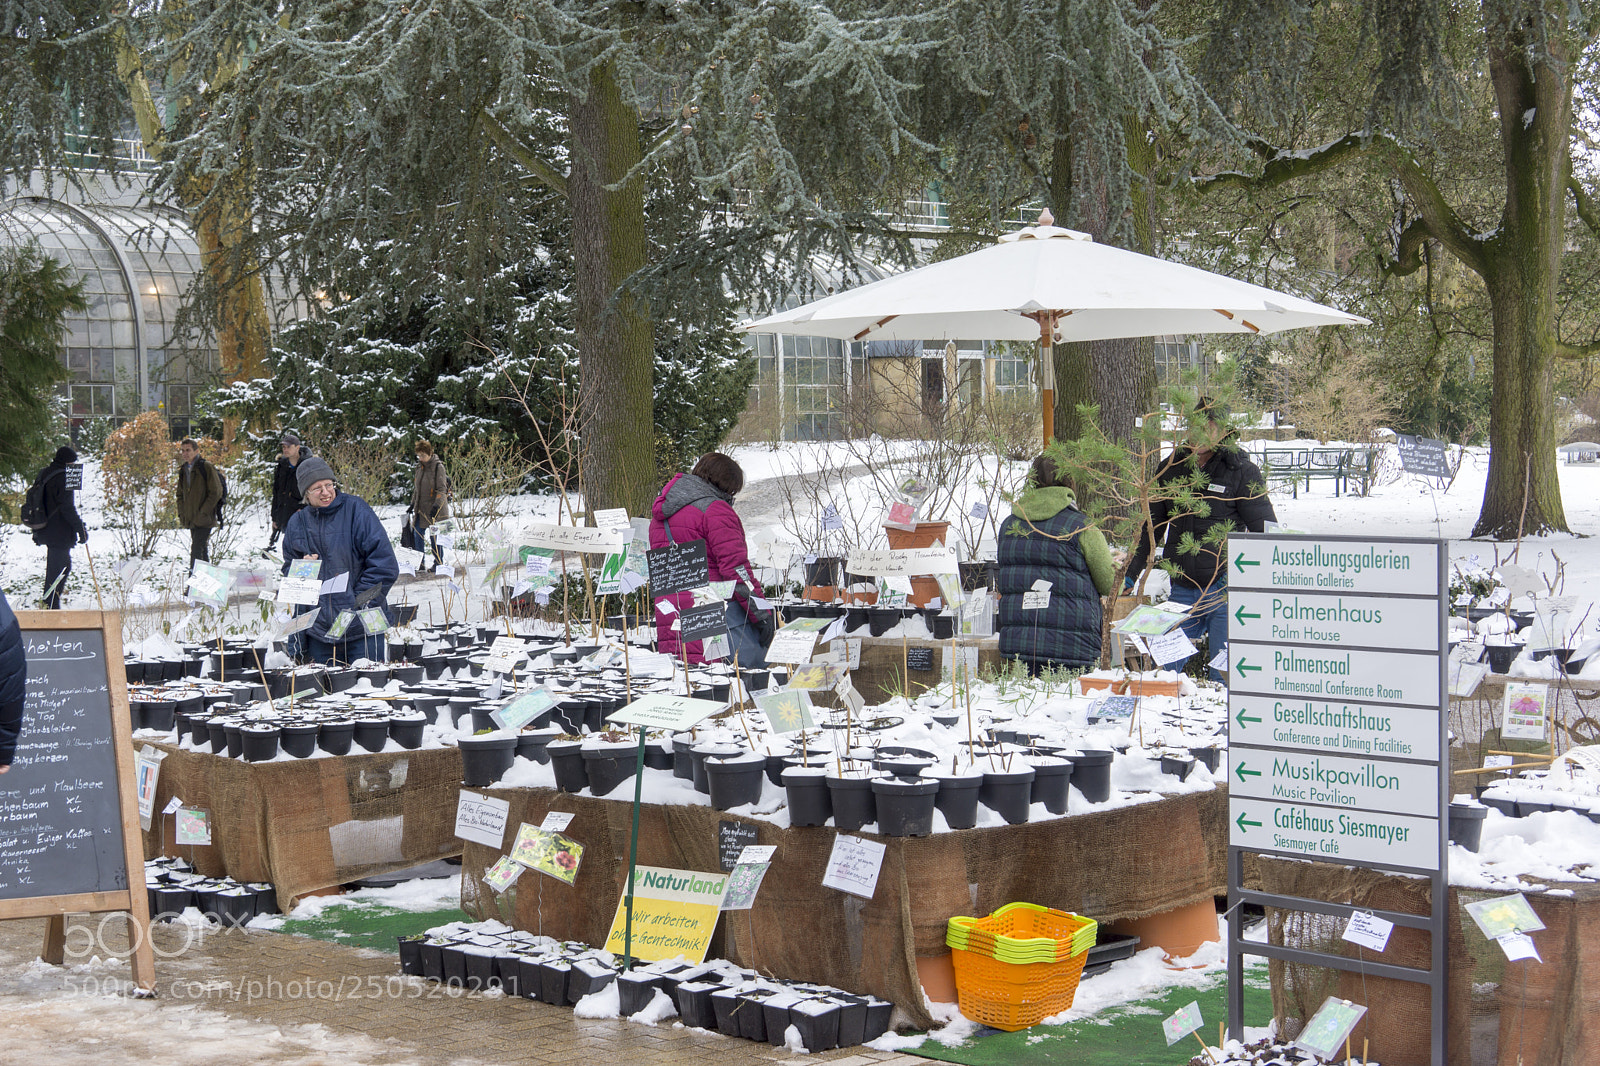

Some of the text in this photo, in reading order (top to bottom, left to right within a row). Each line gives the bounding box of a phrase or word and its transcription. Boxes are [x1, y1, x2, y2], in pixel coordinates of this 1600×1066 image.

[870, 554, 883, 562] der
[1272, 545, 1410, 573] Ausstellungsgalerien
[1272, 572, 1354, 588] Exhibition Galleries
[1272, 597, 1382, 624] Palmenhaus
[1272, 624, 1340, 641] Palm House
[23, 636, 84, 654] heiten
[1275, 650, 1350, 675] Palmensaal
[1275, 677, 1403, 699] Palmensaal Conference Room
[1274, 702, 1391, 732] Gesellschaftshaus
[1274, 728, 1412, 754] Conference and Dining Facilities
[1272, 757, 1400, 790] Musikpavillon
[29, 784, 46, 795] und
[66, 795, 82, 805] XL
[1272, 783, 1356, 805] Music Pavilion
[1274, 807, 1410, 845] Caféhaus Siesmayer
[1274, 834, 1340, 854] Siesmayer Café
[17, 866, 31, 874] XL
[19, 876, 35, 884] XL
[643, 871, 726, 895] Naturland
[631, 910, 699, 929] Wir arbeiten
[611, 928, 707, 950] ohe Gentechnik!
